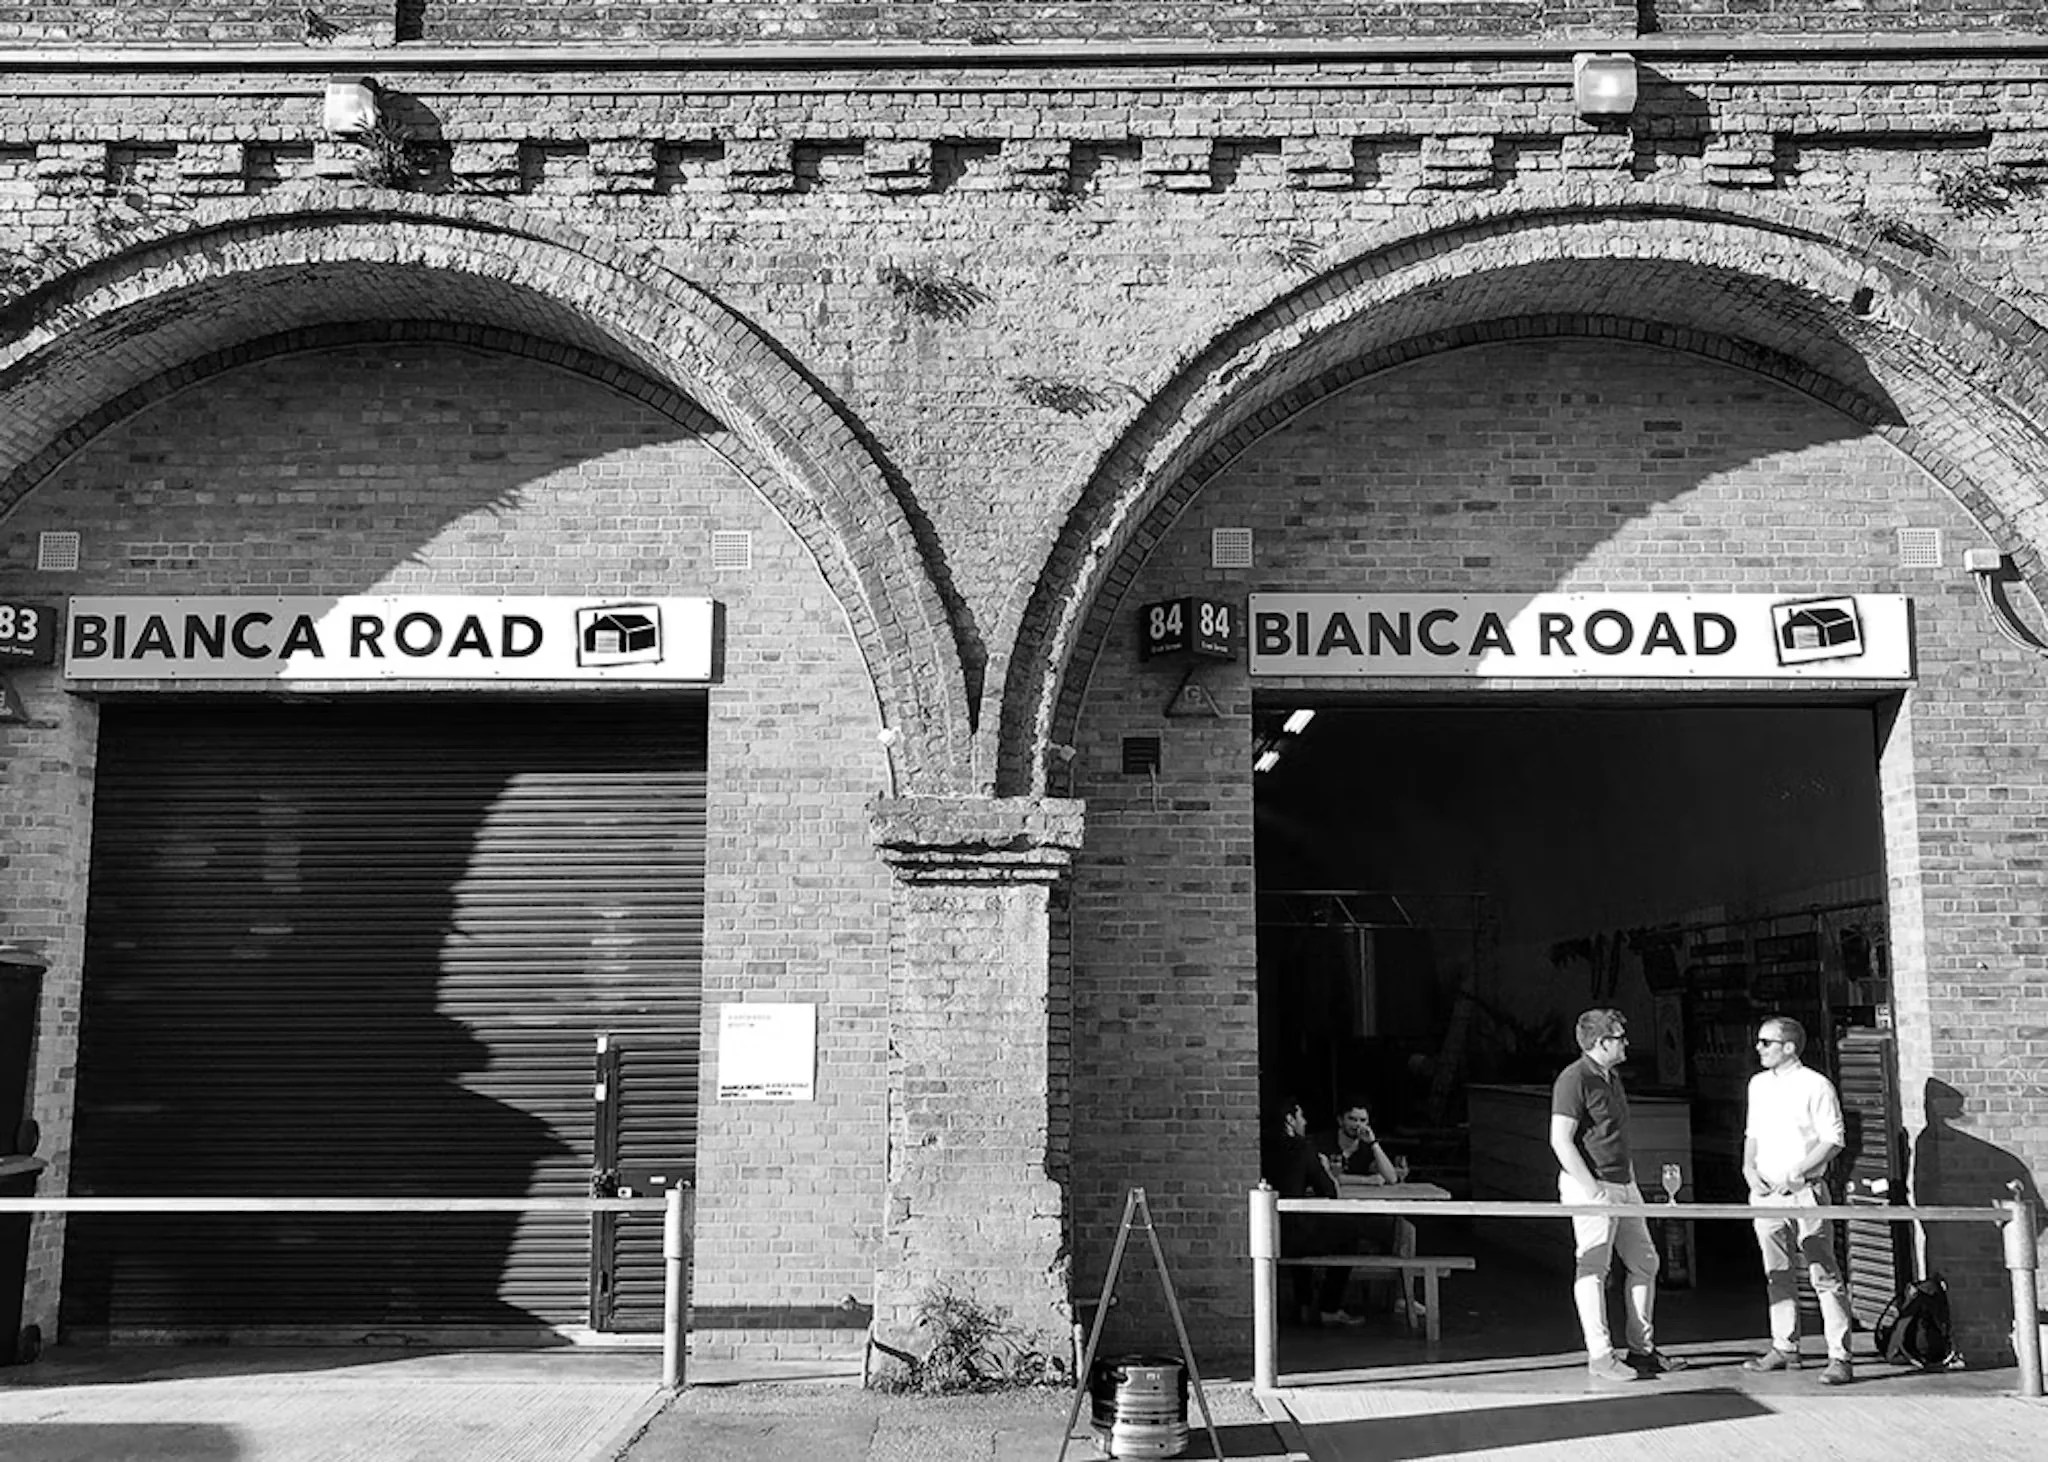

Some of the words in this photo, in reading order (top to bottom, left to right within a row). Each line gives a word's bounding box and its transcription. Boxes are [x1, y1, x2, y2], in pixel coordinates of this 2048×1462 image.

[0, 605, 38, 641] 83
[71, 612, 324, 660] BIANCA
[350, 612, 543, 658] ROAD
[1149, 603, 1183, 640] 84
[1200, 603, 1230, 638] 84
[1255, 609, 1515, 656] BIANCA
[1540, 611, 1737, 656] ROAD
